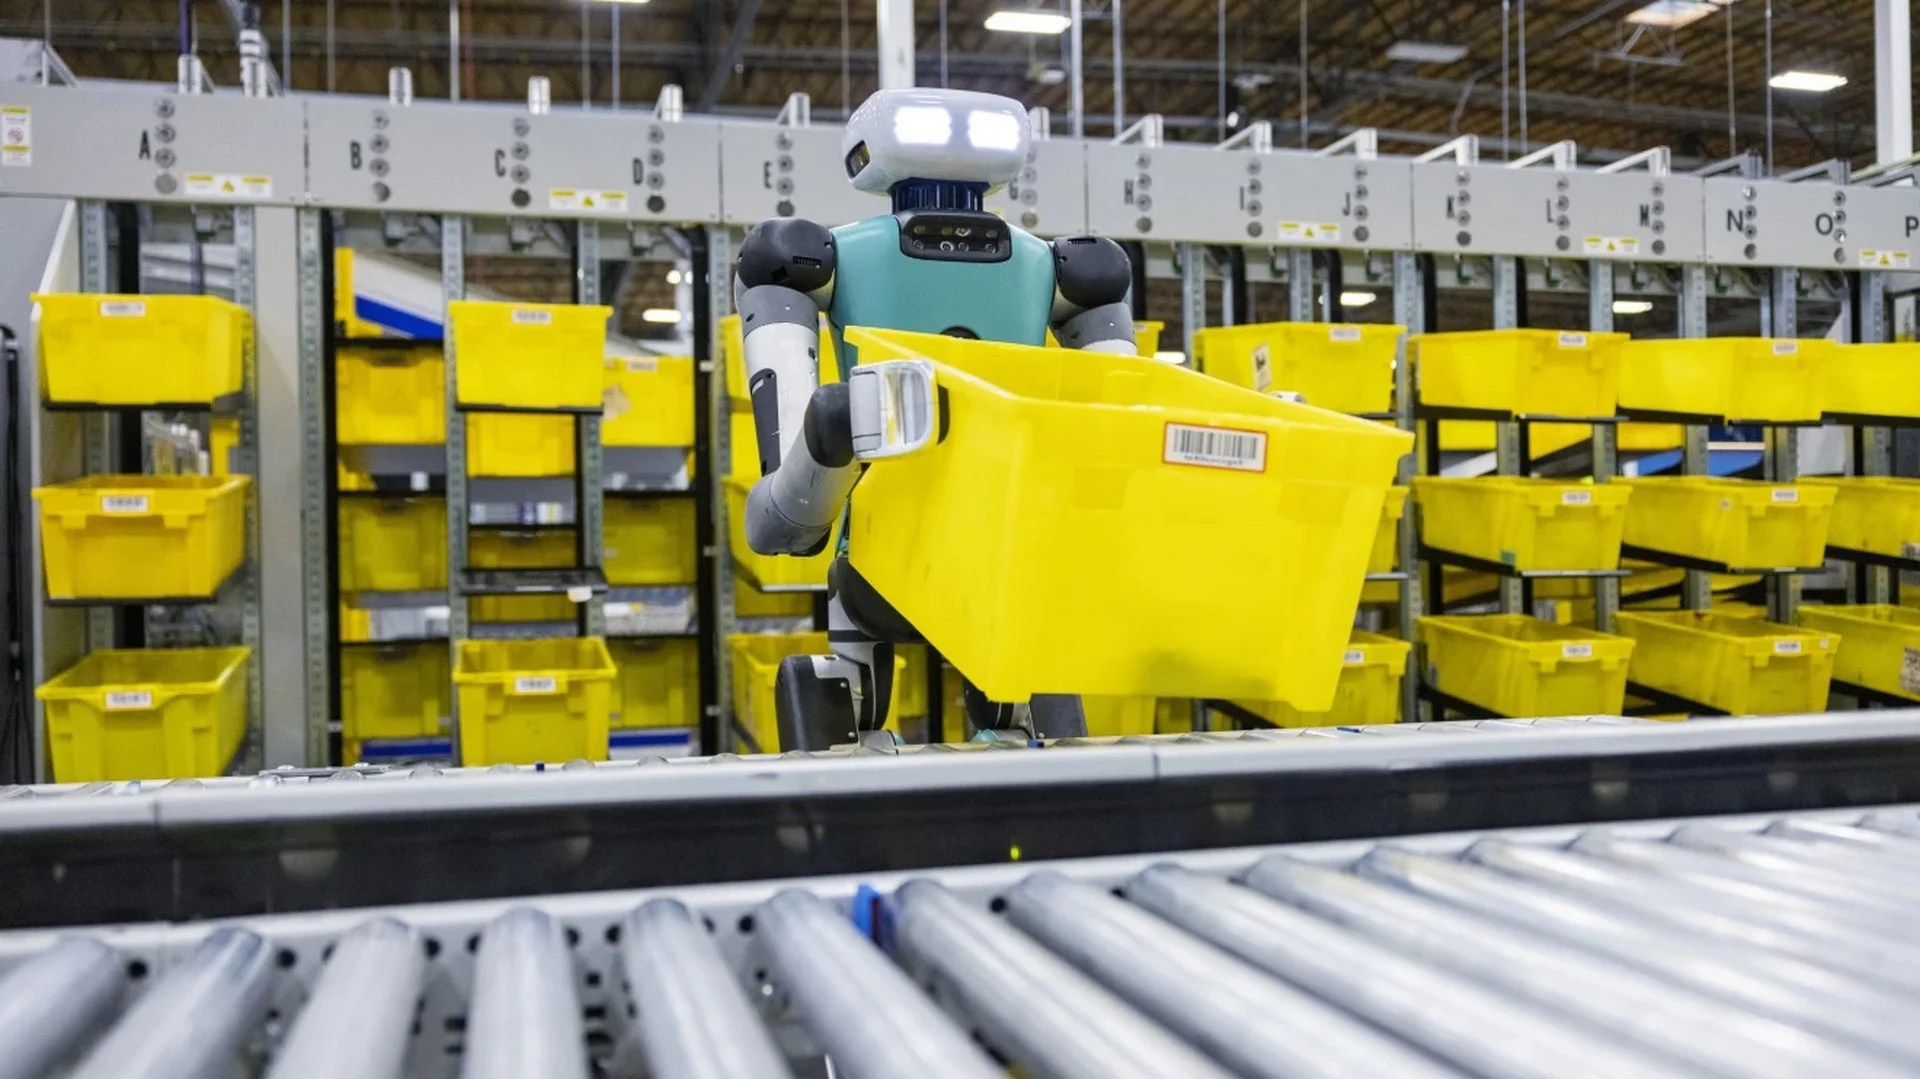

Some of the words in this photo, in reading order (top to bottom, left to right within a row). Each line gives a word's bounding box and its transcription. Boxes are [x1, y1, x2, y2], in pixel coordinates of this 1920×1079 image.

[139, 130, 151, 160] A
[350, 140, 363, 170] B
[494, 148, 506, 177] C
[632, 157, 644, 186] D
[763, 161, 773, 190] E
[1124, 180, 1134, 205] H
[1341, 191, 1351, 217] J
[1446, 195, 1457, 219] K
[1546, 199, 1555, 224] L
[1639, 204, 1650, 227] M
[1726, 208, 1744, 233] N
[1815, 212, 1834, 236] O
[1905, 215, 1920, 239] P
